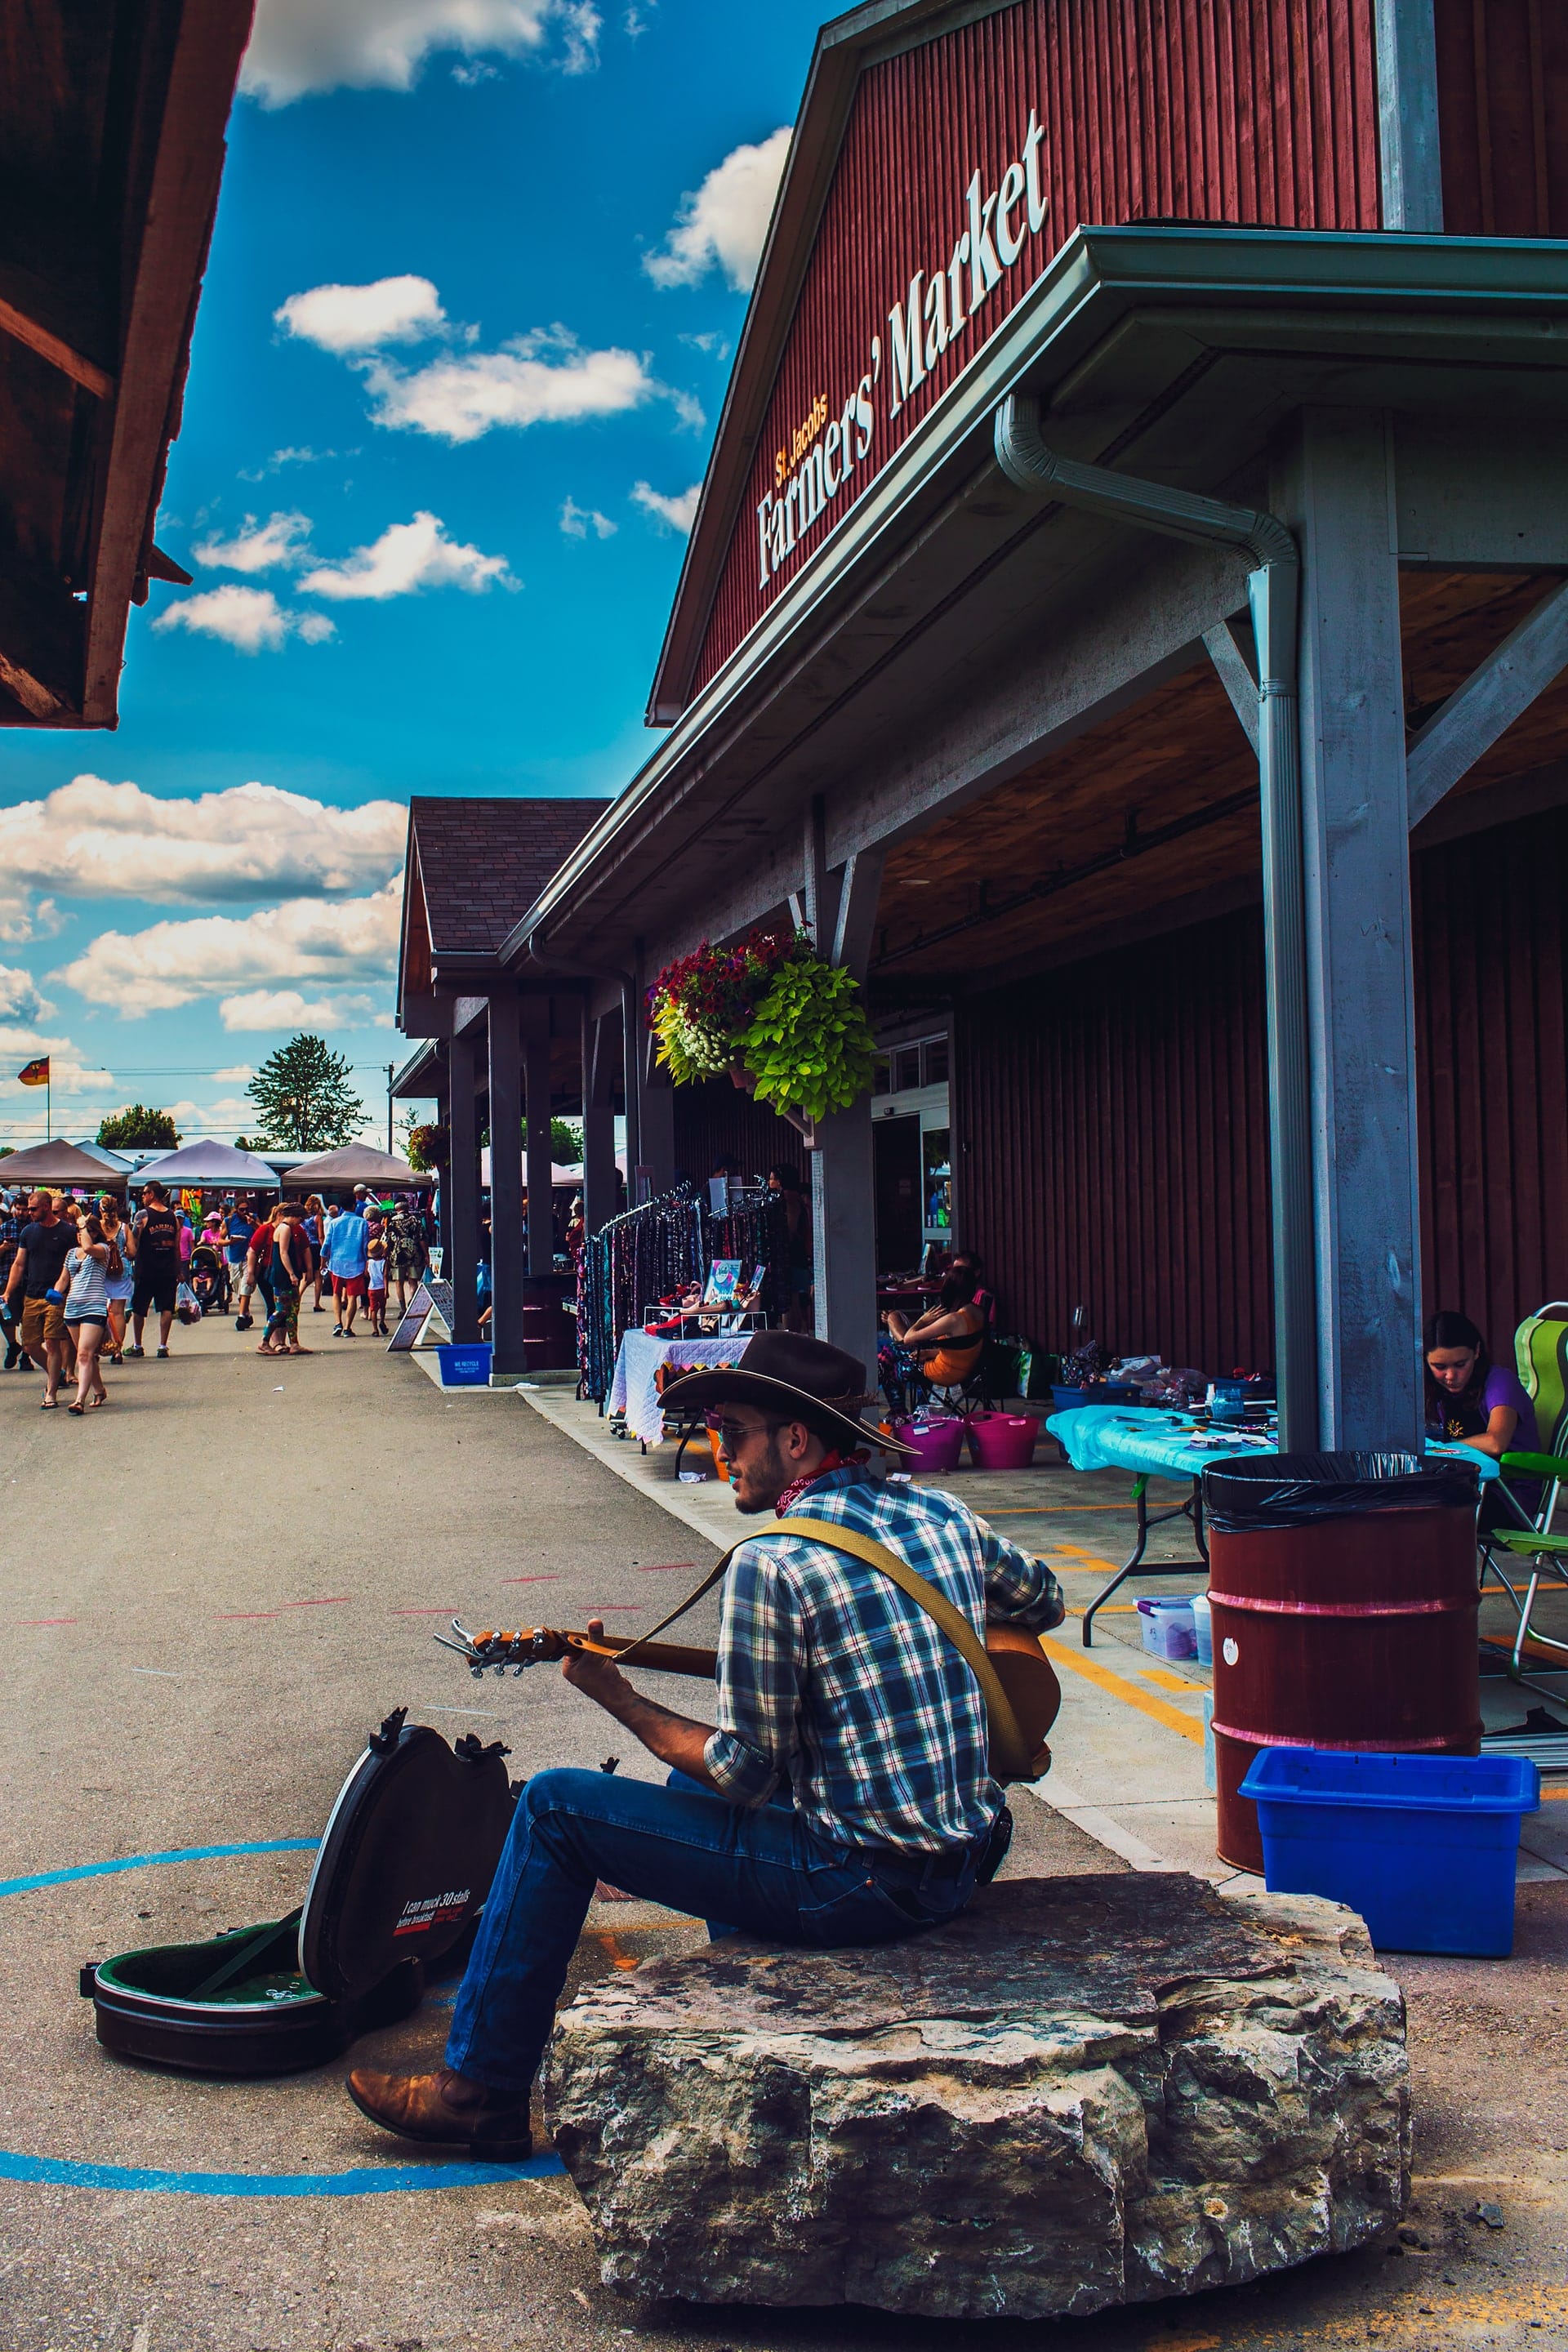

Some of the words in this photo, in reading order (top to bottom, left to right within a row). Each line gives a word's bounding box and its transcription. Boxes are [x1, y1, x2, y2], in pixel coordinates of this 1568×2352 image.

[889, 108, 1049, 420] Market
[775, 446, 791, 488] St.
[790, 394, 827, 468] Jacobs
[402, 1900, 410, 1916] I
[407, 1901, 422, 1914] can
[421, 1895, 442, 1911] muck
[439, 1891, 455, 1907] 30
[452, 1889, 470, 1904] stalls
